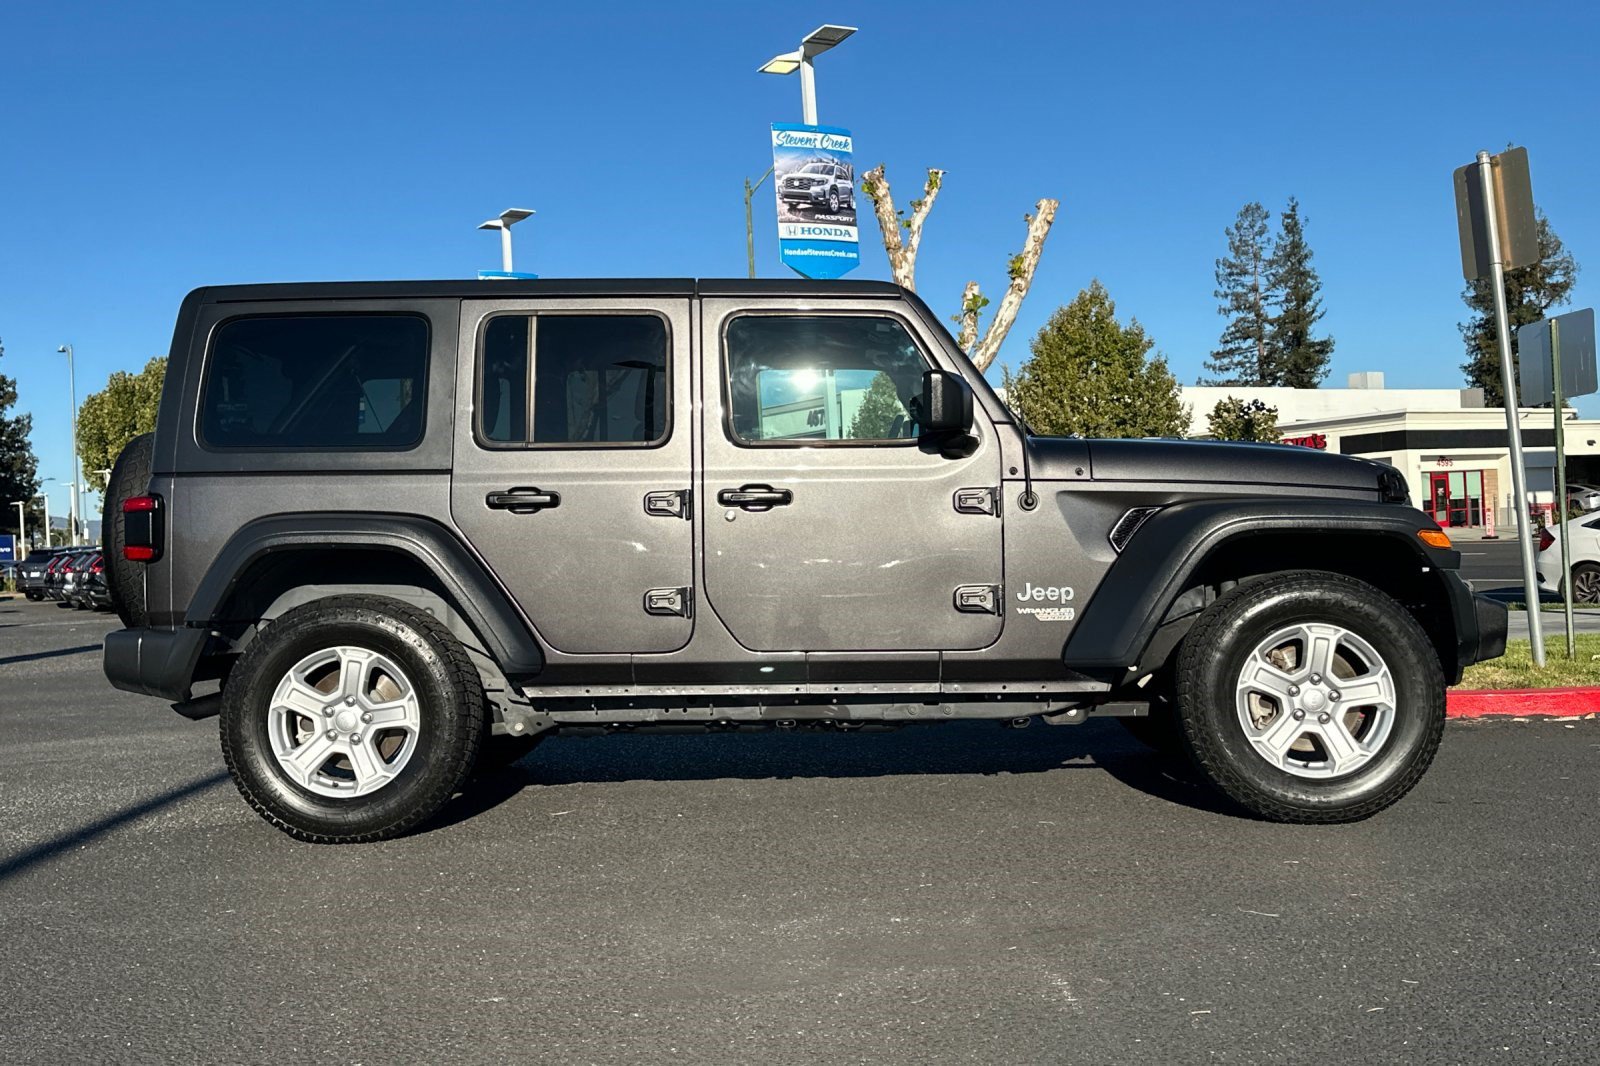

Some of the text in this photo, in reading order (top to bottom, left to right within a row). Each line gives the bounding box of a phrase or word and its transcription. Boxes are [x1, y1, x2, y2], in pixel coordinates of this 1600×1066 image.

[776, 131, 850, 149] Stevens Creek
[815, 214, 854, 222] PASSPORT
[801, 226, 853, 238] HONDA
[784, 248, 858, 258] HondaofStevensCreek.com
[1436, 458, 1453, 467] 4595
[1016, 582, 1075, 605] Jeep
